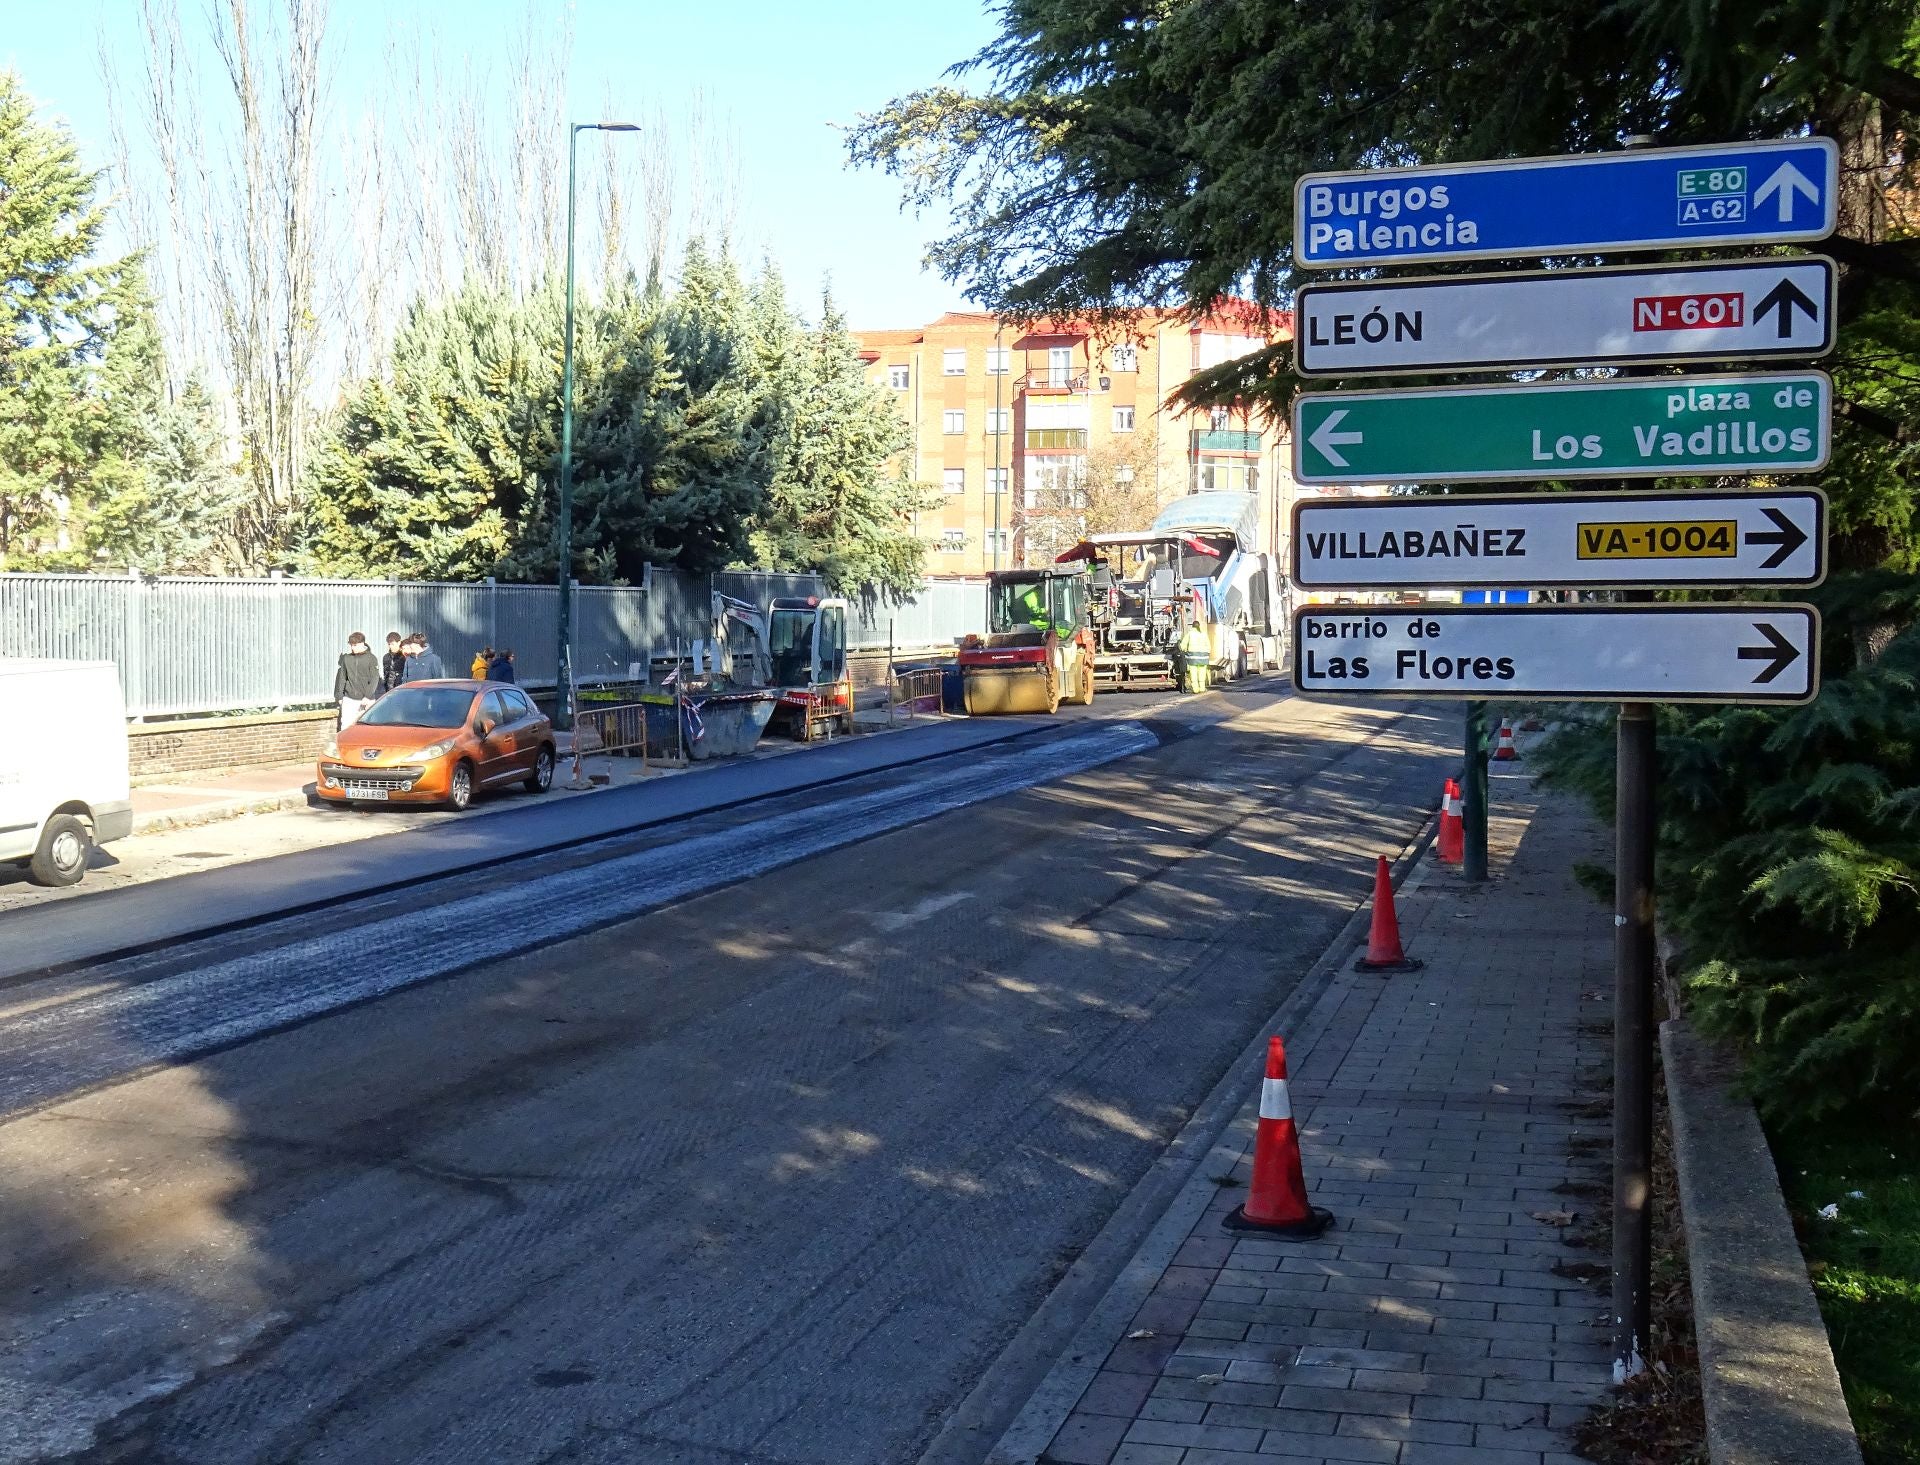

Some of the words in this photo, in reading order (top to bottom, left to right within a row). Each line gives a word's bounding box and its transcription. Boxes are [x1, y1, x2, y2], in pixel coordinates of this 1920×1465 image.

[1681, 170, 1743, 193] E-80
[1309, 184, 1450, 220] Burgos
[1682, 199, 1742, 222] A-62
[1309, 214, 1479, 254] Palencia
[1309, 306, 1423, 346] LEÓN
[1638, 297, 1741, 327] N-601
[1667, 388, 1751, 418] plaza
[1773, 386, 1813, 409] de
[1532, 430, 1603, 461] Los
[1633, 422, 1813, 457] Vadillos
[1306, 524, 1526, 560] VILLABAÑEZ
[1583, 526, 1731, 554] VA-1004
[1306, 617, 1388, 639] barrio
[1407, 618, 1441, 639] de
[1306, 650, 1370, 680] Las
[1396, 648, 1515, 681] Flores
